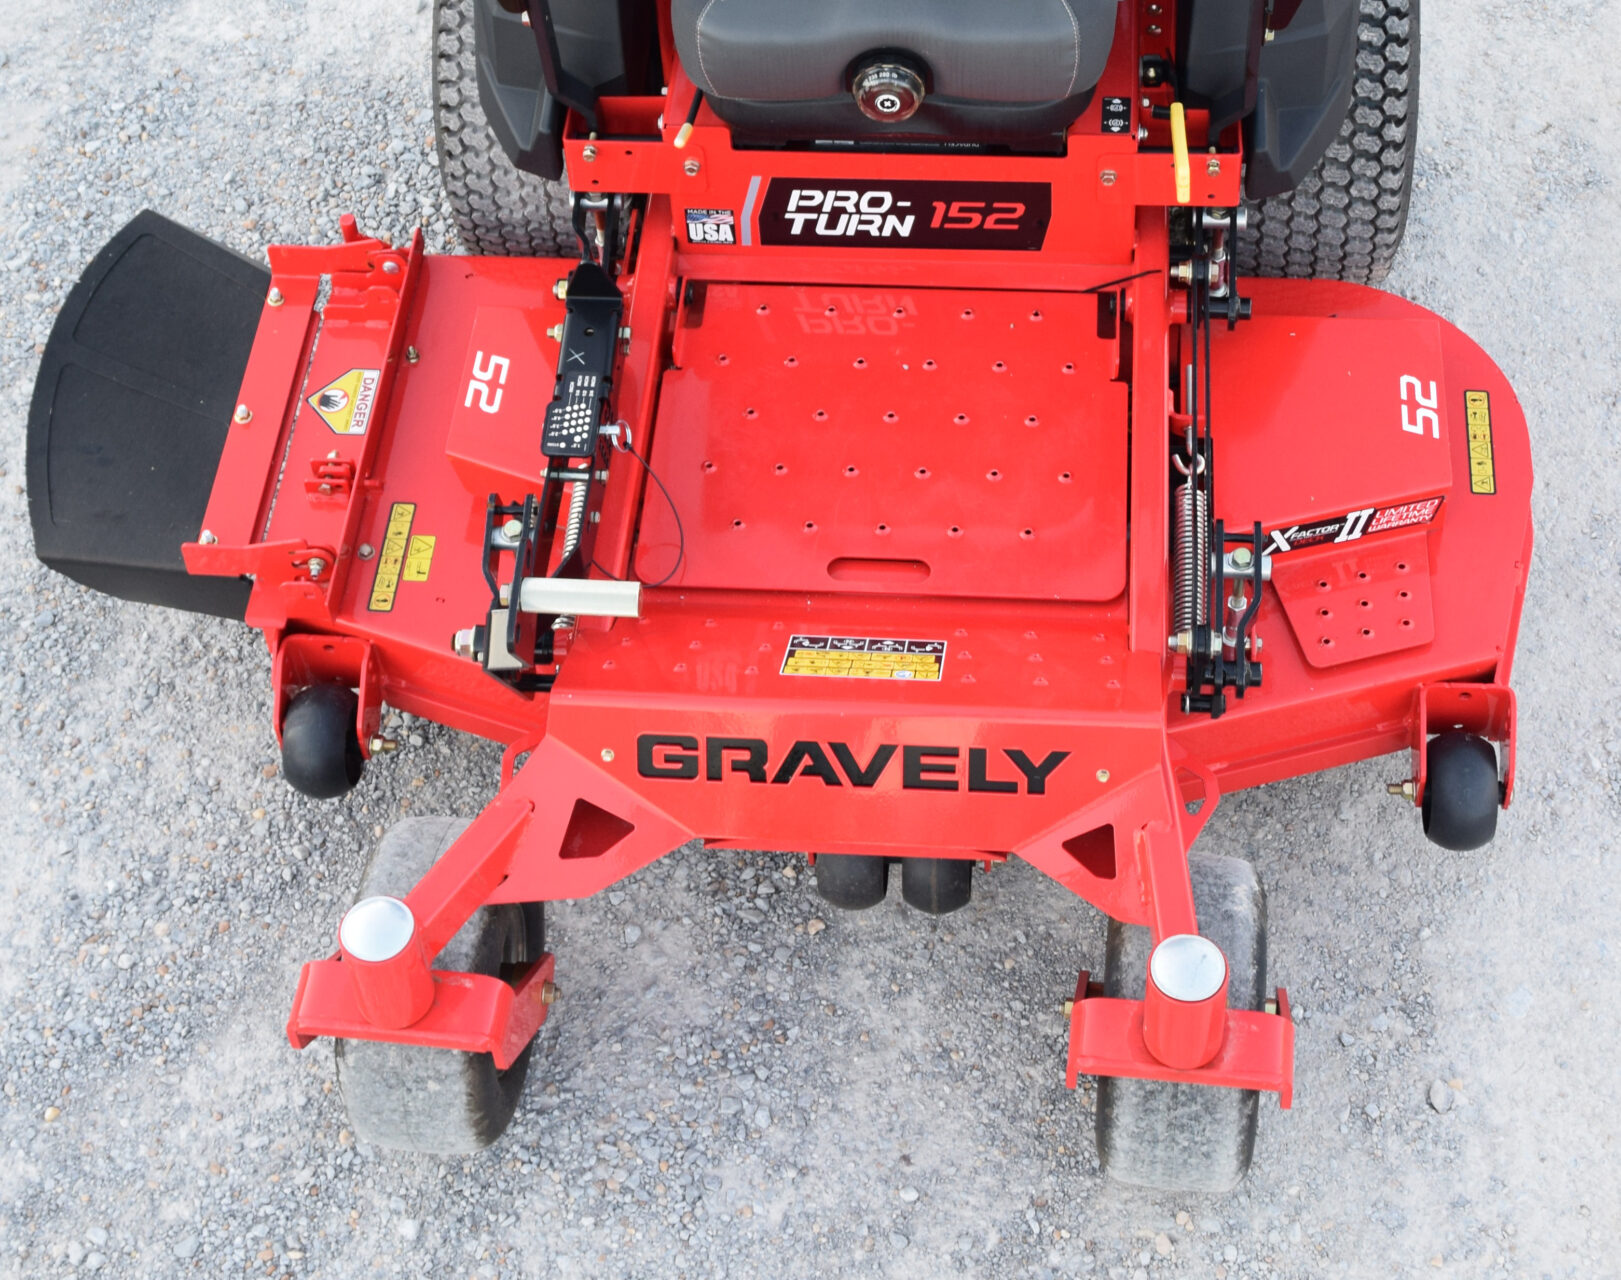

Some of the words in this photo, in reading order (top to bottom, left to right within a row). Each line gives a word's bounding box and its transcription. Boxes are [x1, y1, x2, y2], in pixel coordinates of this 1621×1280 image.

[786, 189, 912, 213] PRO-
[784, 213, 916, 238] TURN
[929, 200, 1027, 230] 152
[688, 223, 734, 242] USA
[464, 350, 511, 414] 52
[351, 377, 375, 428] DANGER
[1400, 374, 1440, 440] 52
[1375, 498, 1438, 519] LIMITED
[1367, 515, 1434, 533] WARRANTY
[636, 732, 1073, 796] GRAVELY
